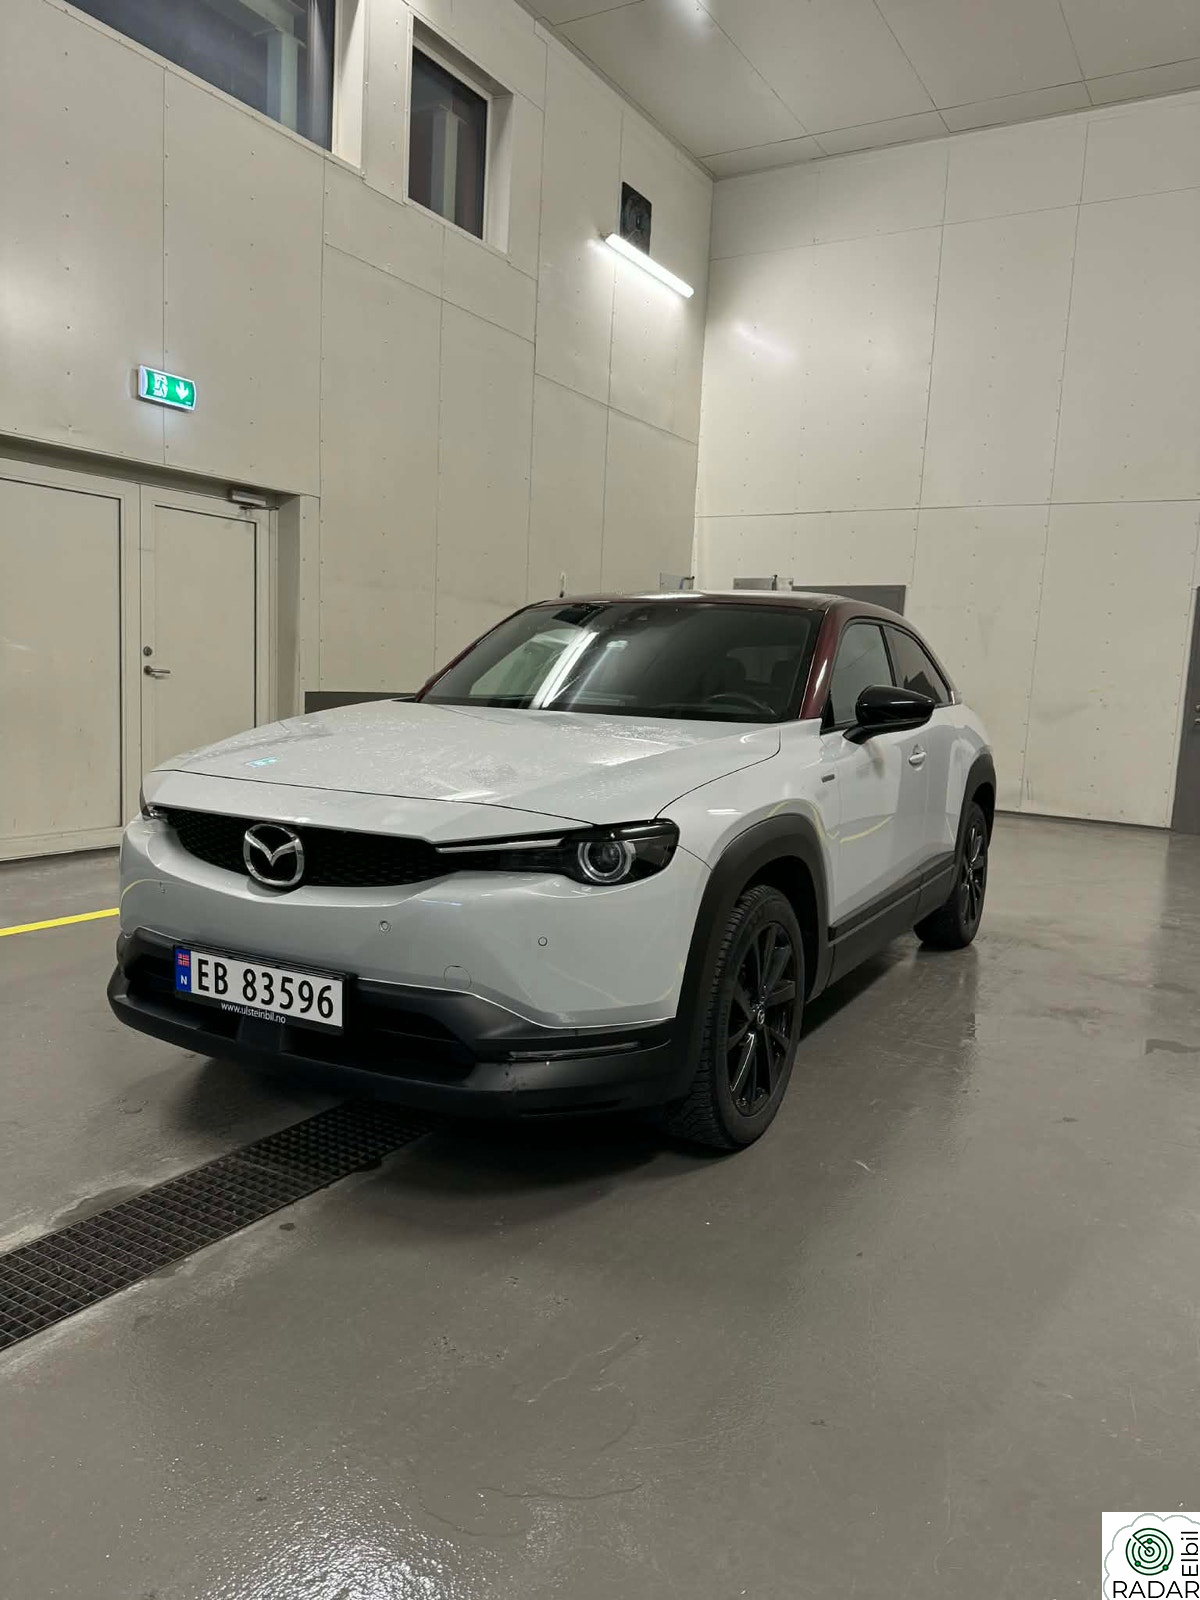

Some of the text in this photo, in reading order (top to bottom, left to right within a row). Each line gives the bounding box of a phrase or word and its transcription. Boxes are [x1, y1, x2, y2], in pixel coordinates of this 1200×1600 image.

[180, 974, 188, 985] N
[197, 958, 334, 1019] EB 83596
[221, 1002, 286, 1024] www.ulsteinbil.no
